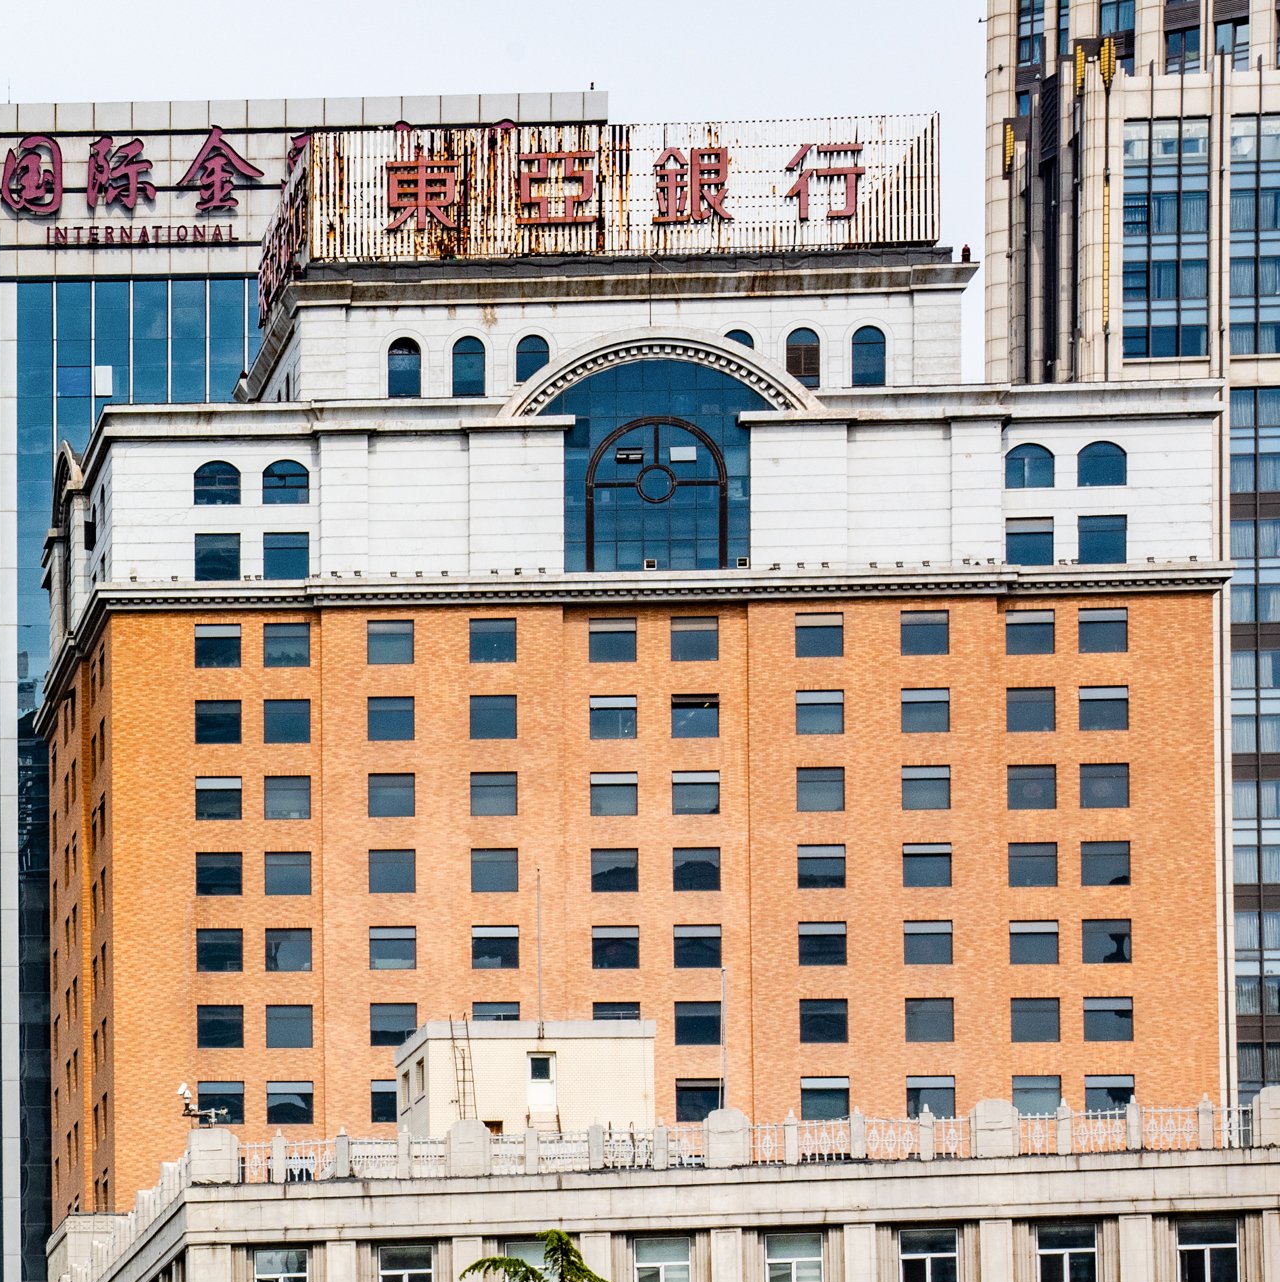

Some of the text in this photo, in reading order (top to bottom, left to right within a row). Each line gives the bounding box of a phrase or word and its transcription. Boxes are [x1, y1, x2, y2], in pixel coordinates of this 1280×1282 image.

[1, 124, 310, 213] 国际金
[385, 142, 866, 231] 東亞銀行
[46, 223, 239, 247] INTERNATIONAL
